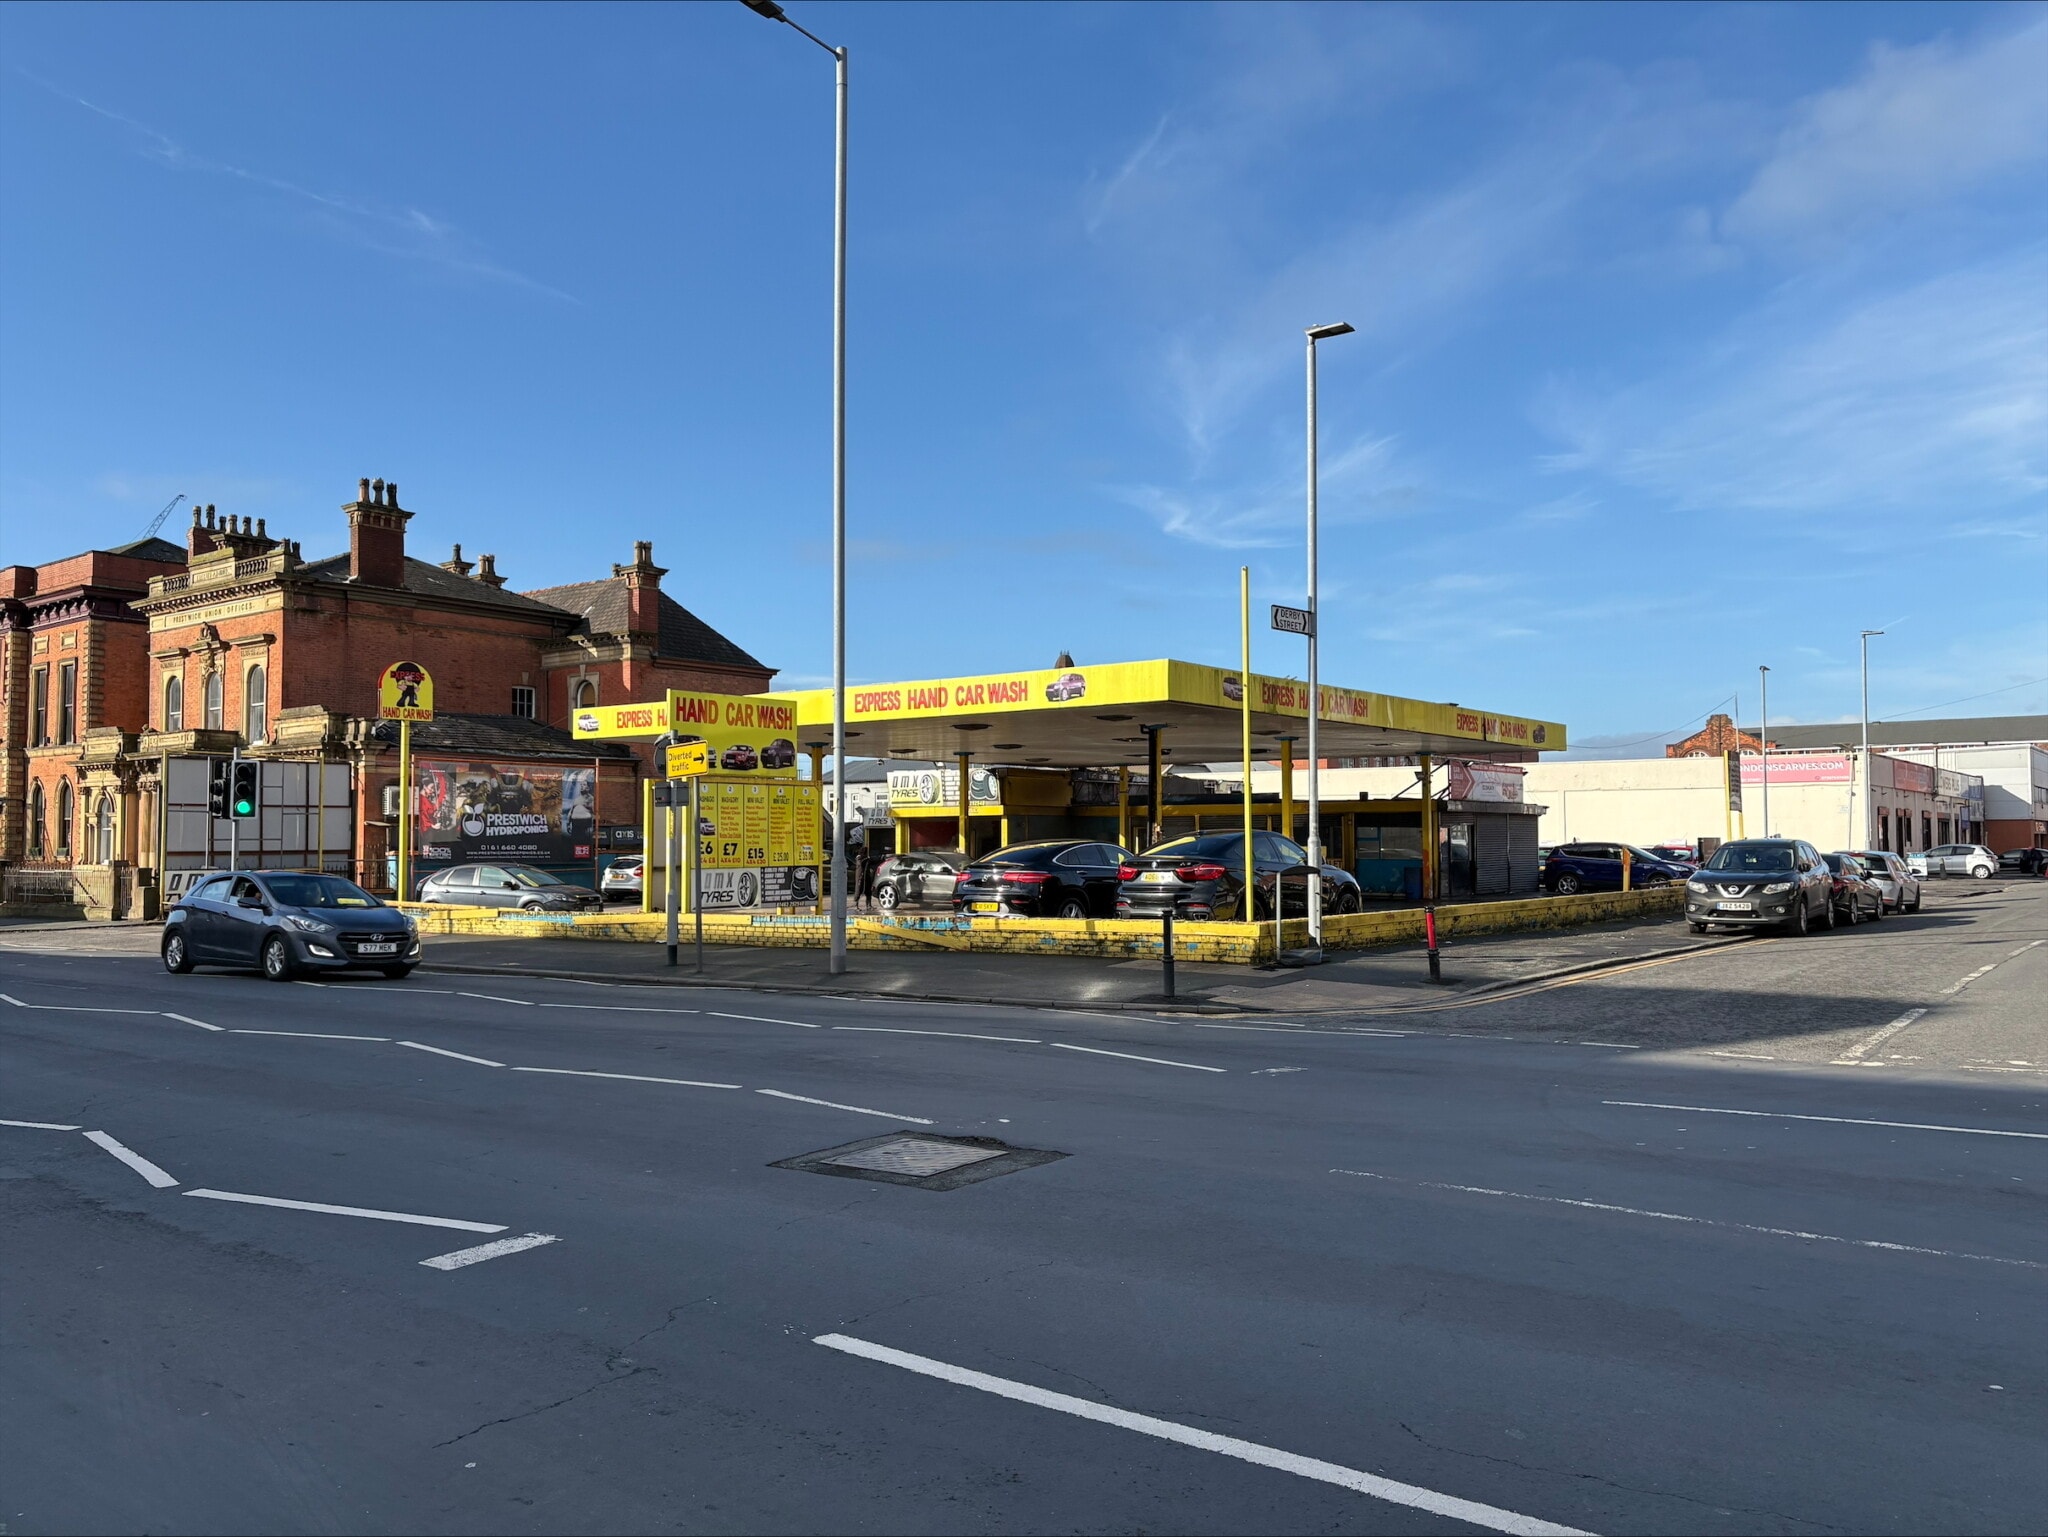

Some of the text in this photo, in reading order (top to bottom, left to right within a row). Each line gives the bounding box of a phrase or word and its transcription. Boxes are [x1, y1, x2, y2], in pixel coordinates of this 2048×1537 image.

[205, 609, 222, 618] UNION
[1280, 609, 1300, 620] DERBY
[1280, 620, 1302, 630] STREET
[854, 680, 1028, 713] EXPRESS HAND CAR WASH
[1262, 683, 1294, 708] EXPRESS
[1328, 693, 1344, 714] CAR
[1345, 696, 1368, 718] WASH
[382, 706, 432, 720] HAND CAR WASH
[676, 696, 793, 730] HAND CAR WASH
[616, 710, 652, 729] EXPRESS
[1456, 713, 1478, 733] EXPRESS
[1500, 721, 1512, 738] CAR
[1512, 722, 1528, 740] WASH
[668, 751, 692, 762] Diverted
[672, 762, 690, 772] traffic
[892, 788, 919, 798] TYRES
[486, 813, 548, 826] PRESTWICH
[486, 825, 548, 836] HYDROPONICS
[616, 830, 634, 838] axis
[723, 843, 738, 856] £7
[748, 848, 764, 859] £15
[700, 890, 735, 903] TYRES
